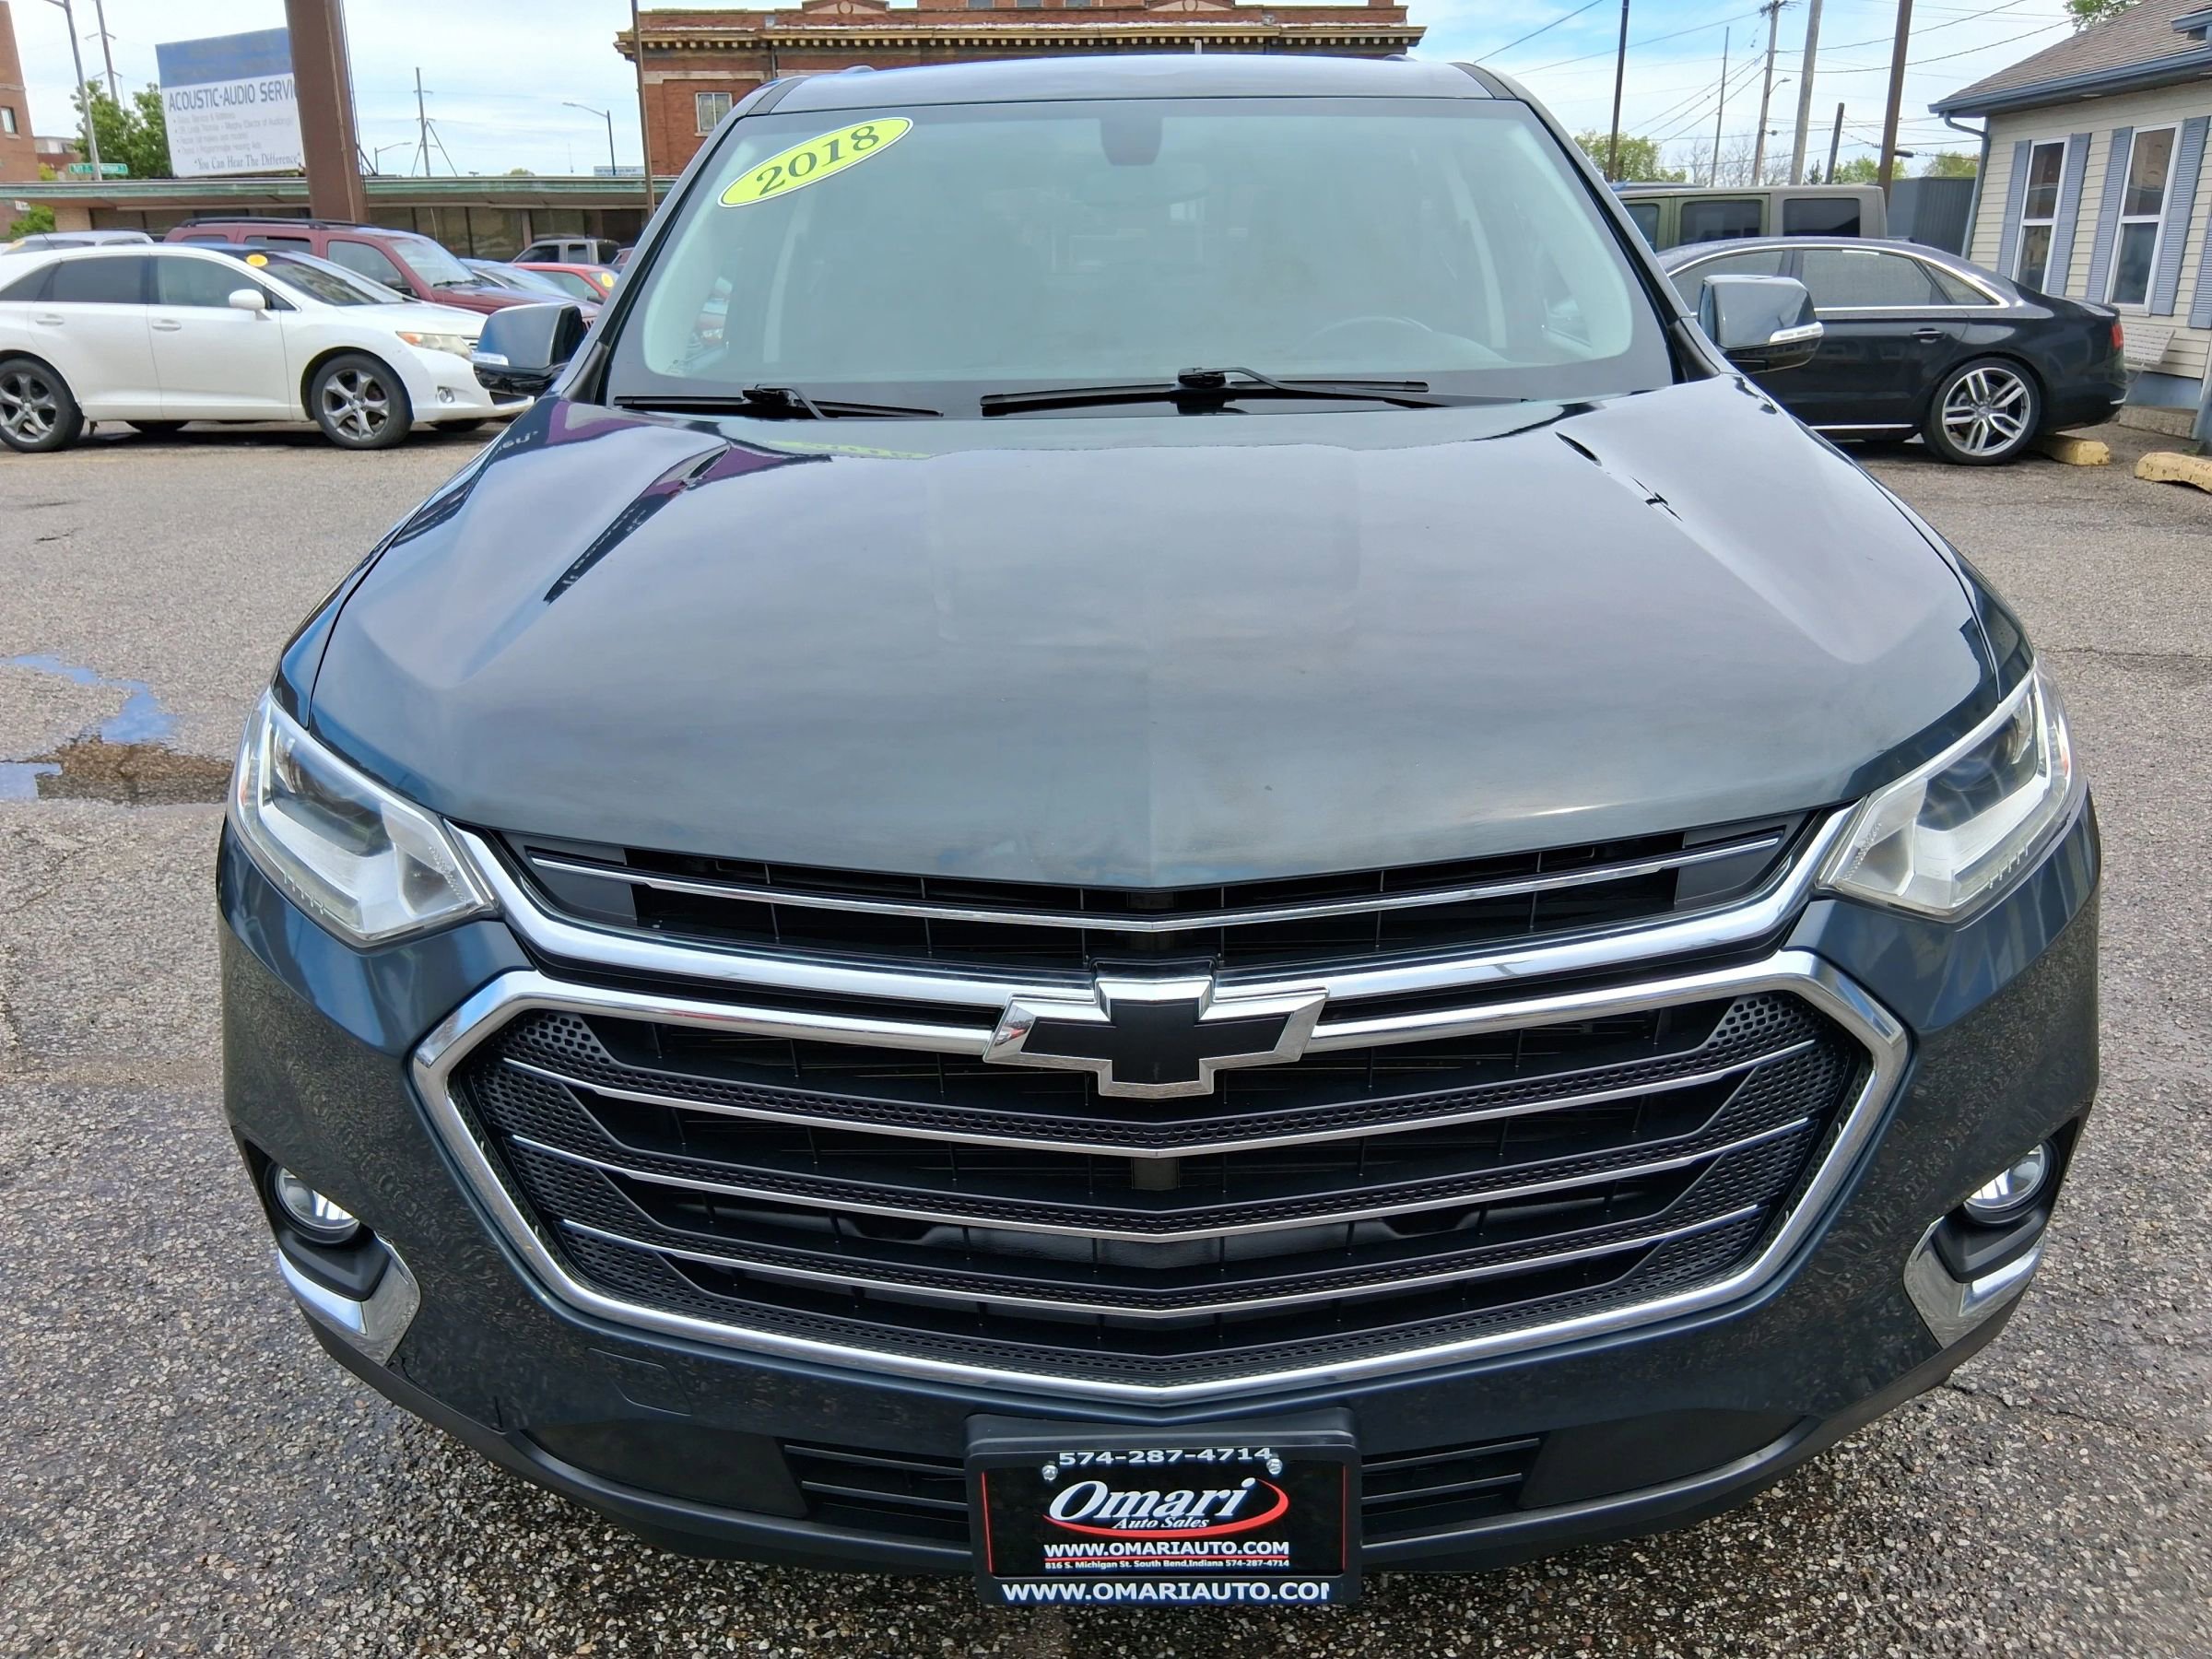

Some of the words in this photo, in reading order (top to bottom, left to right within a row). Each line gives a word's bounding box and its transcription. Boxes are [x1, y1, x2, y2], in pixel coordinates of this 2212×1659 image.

[259, 78, 296, 102] SERVI
[211, 156, 225, 170] Can
[227, 155, 243, 168] Hear
[244, 154, 259, 167] The
[756, 125, 879, 196] 2018
[1059, 1447, 1272, 1465] 574-287-4714
[1049, 1477, 1256, 1521] Omari
[1112, 1517, 1159, 1529] Auto
[1160, 1516, 1209, 1529] Sales
[1043, 1541, 1289, 1558] WWW.OMARIAUTO.COM
[1044, 1561, 1063, 1570] 816
[1075, 1560, 1118, 1570] Michigan
[1119, 1560, 1132, 1569] St.
[1134, 1559, 1161, 1568] South
